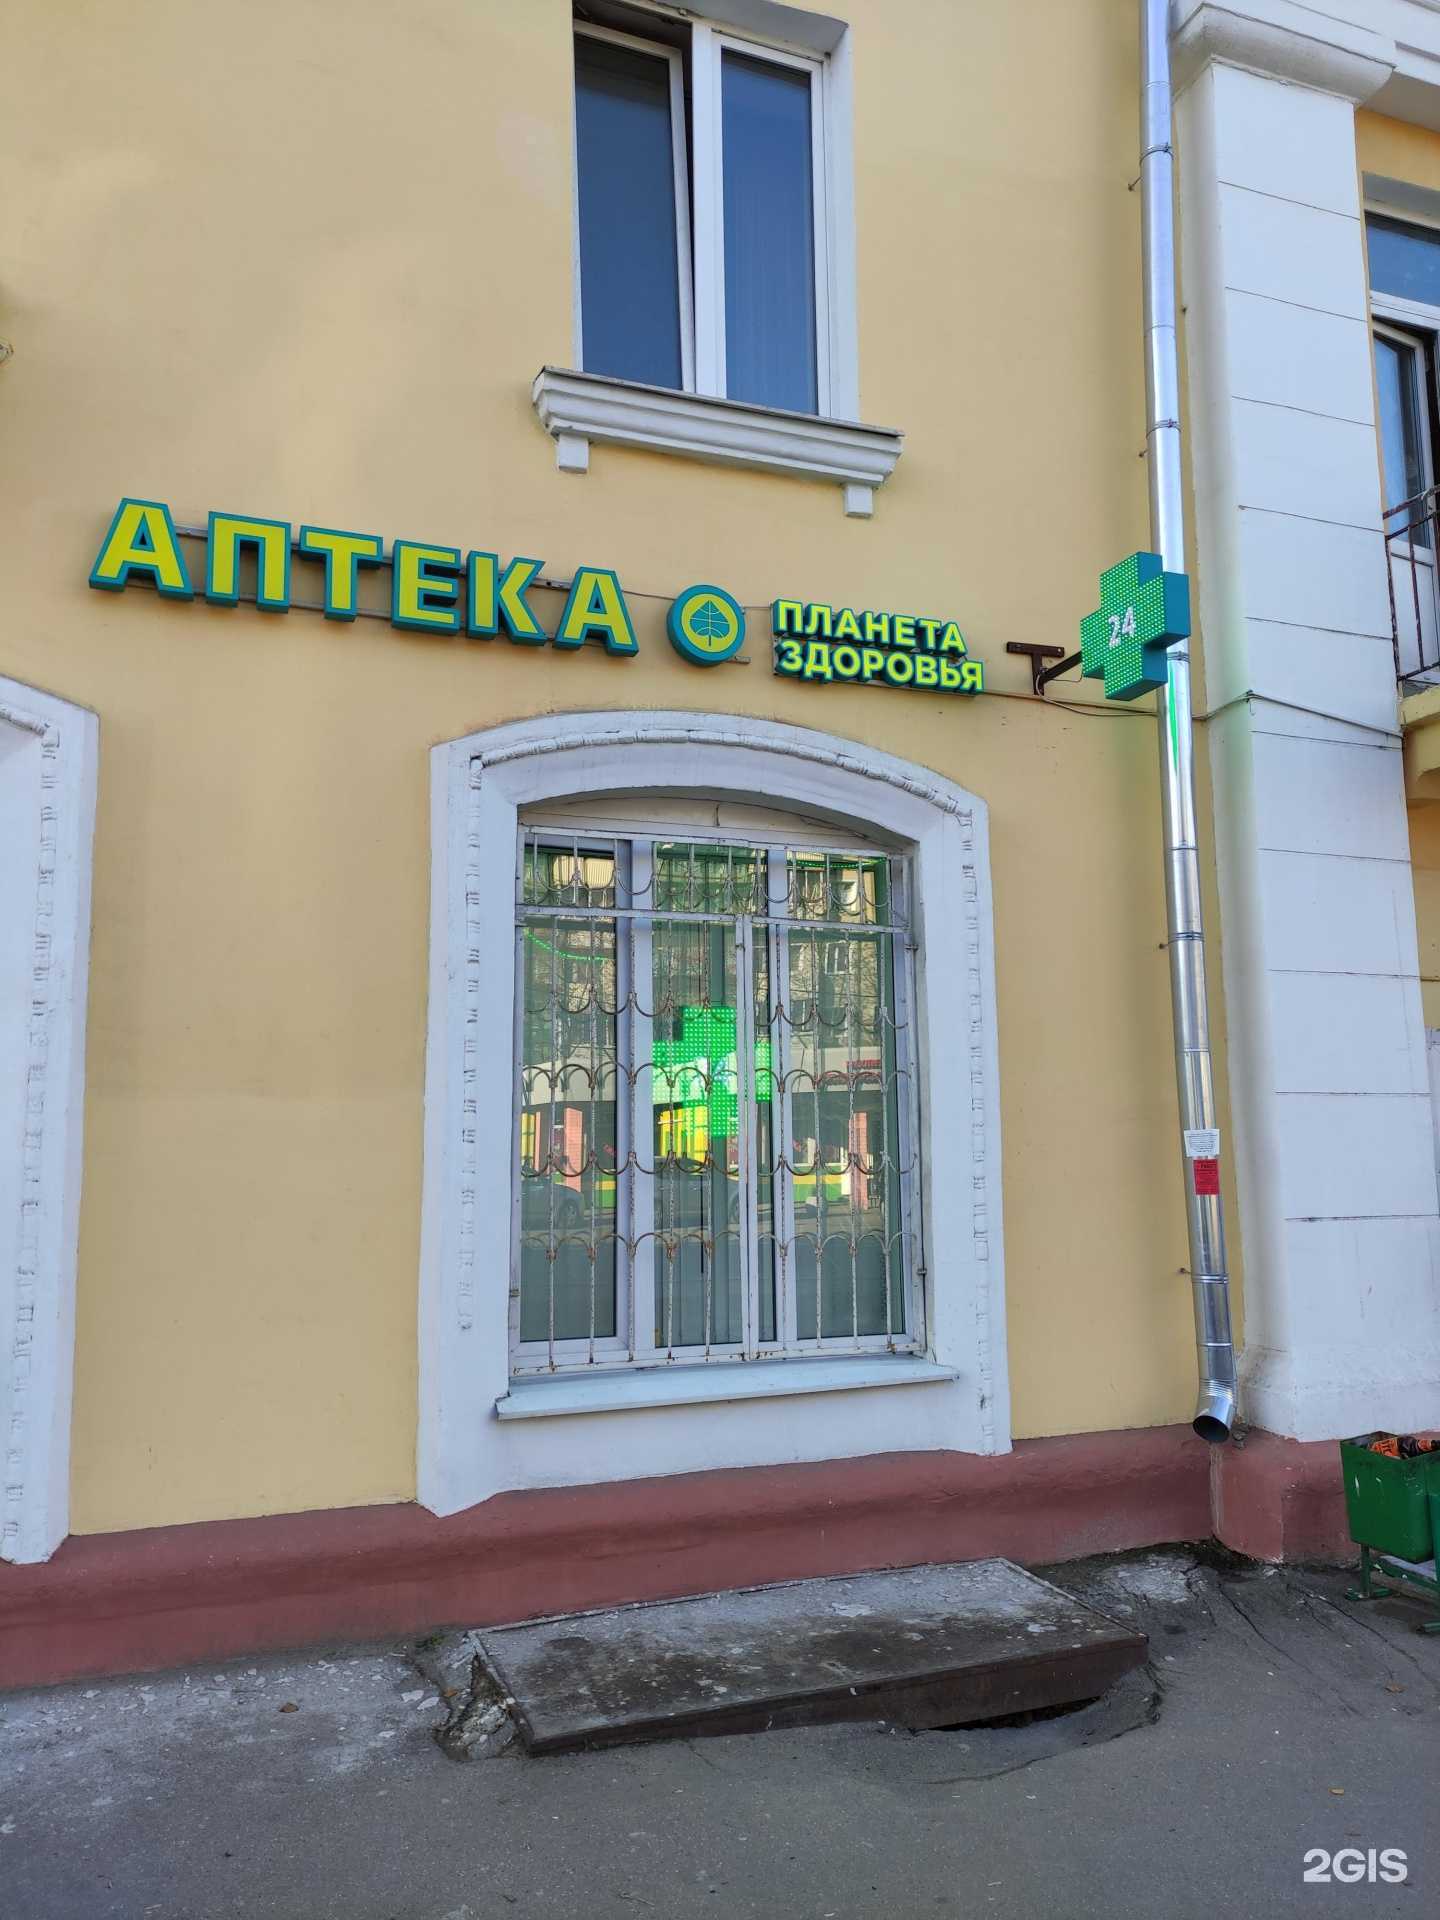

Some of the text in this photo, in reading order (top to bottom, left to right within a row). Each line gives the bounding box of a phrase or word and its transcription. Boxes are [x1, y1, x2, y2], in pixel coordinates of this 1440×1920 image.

[89, 497, 639, 657] АПТЕКА
[774, 599, 968, 655] ПЛАНЕТА
[1108, 606, 1136, 649] 24
[775, 638, 984, 696] ЗДОРОВЬЯ
